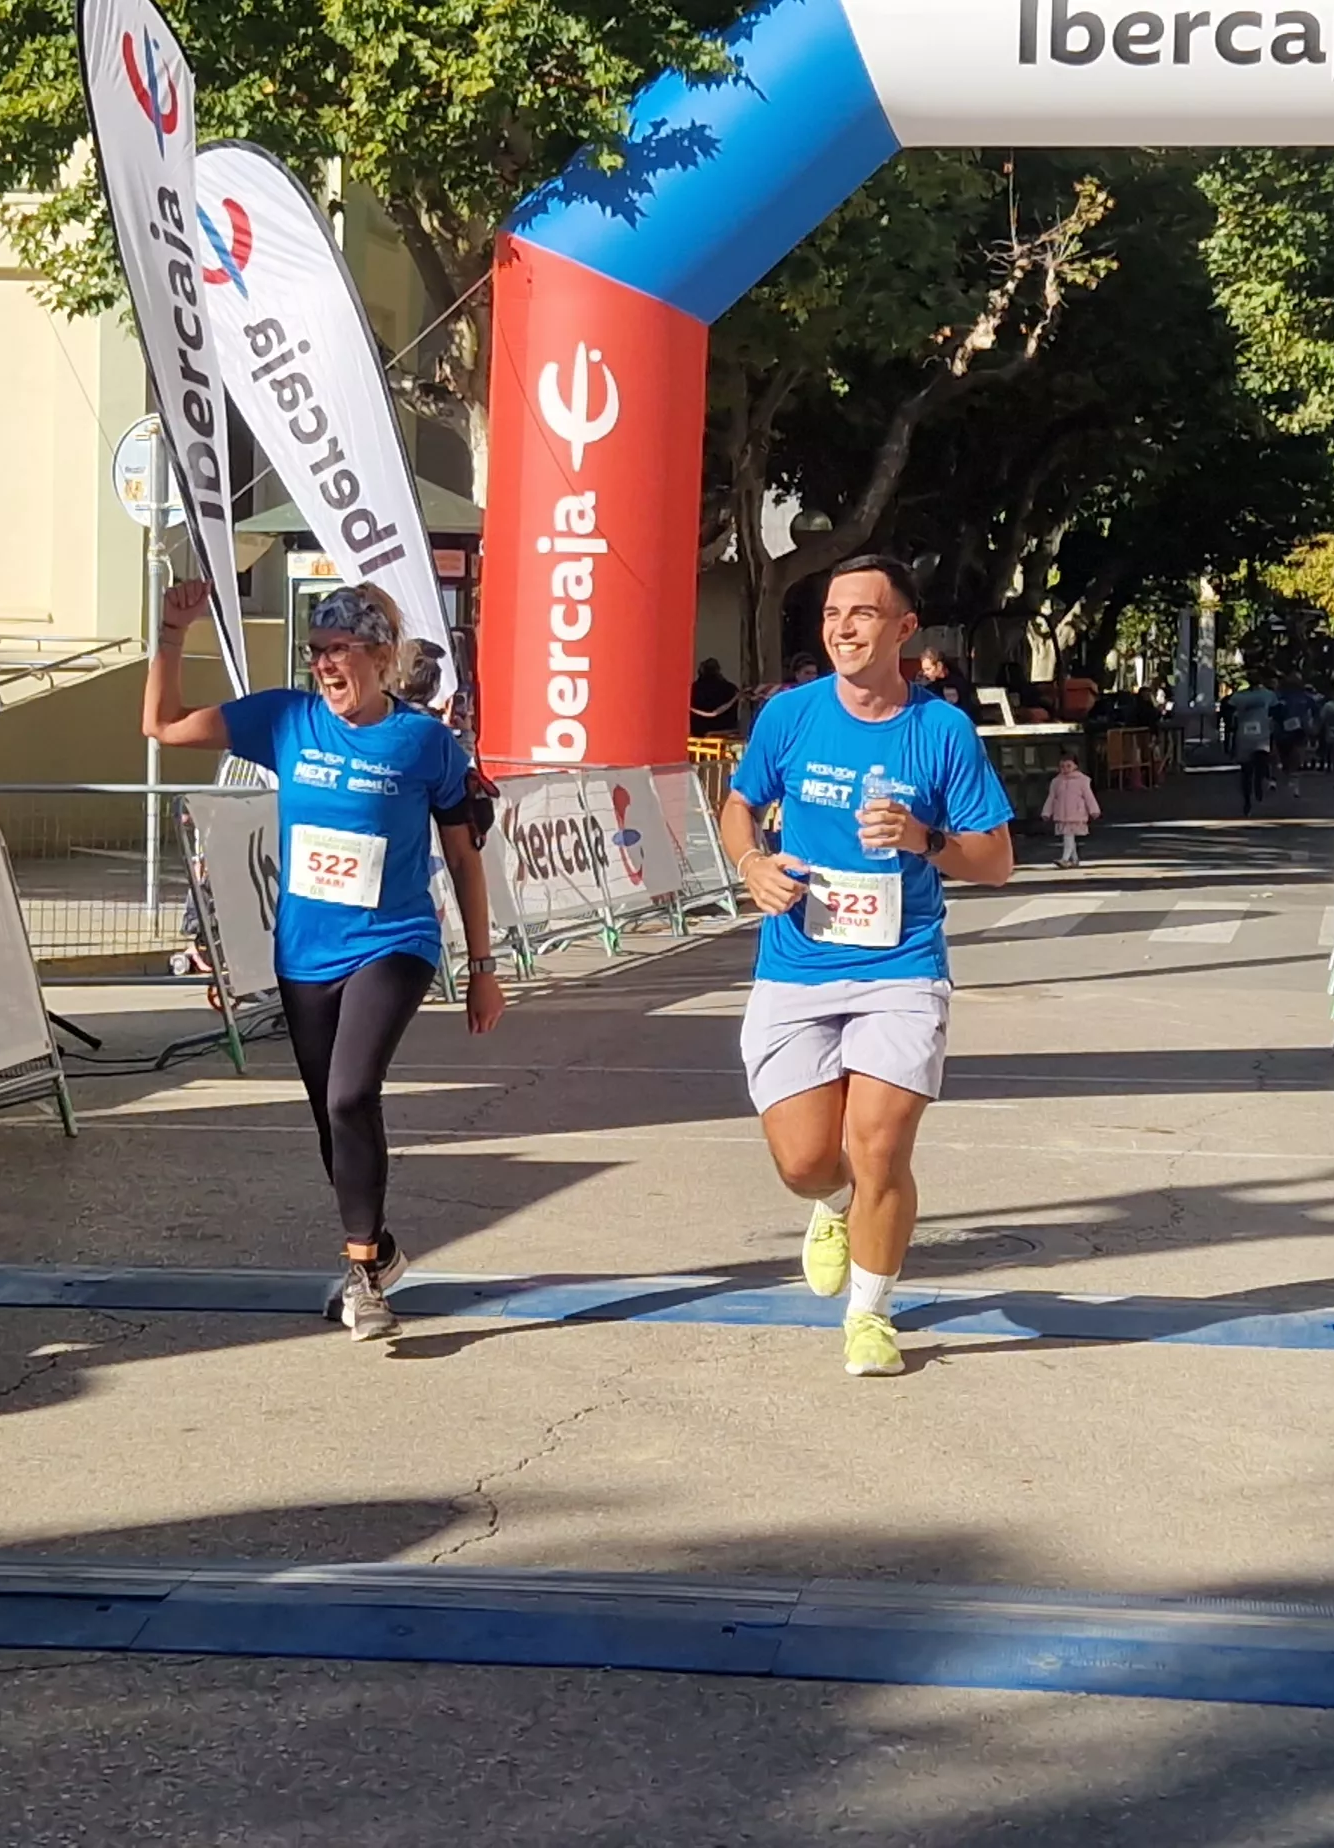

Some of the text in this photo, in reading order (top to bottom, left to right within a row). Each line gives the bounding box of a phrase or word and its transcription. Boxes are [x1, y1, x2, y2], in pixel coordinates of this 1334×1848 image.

[532, 490, 610, 765] bercaja
[801, 778, 853, 802] NEXT
[307, 851, 359, 879] 522
[826, 890, 879, 915] 523
